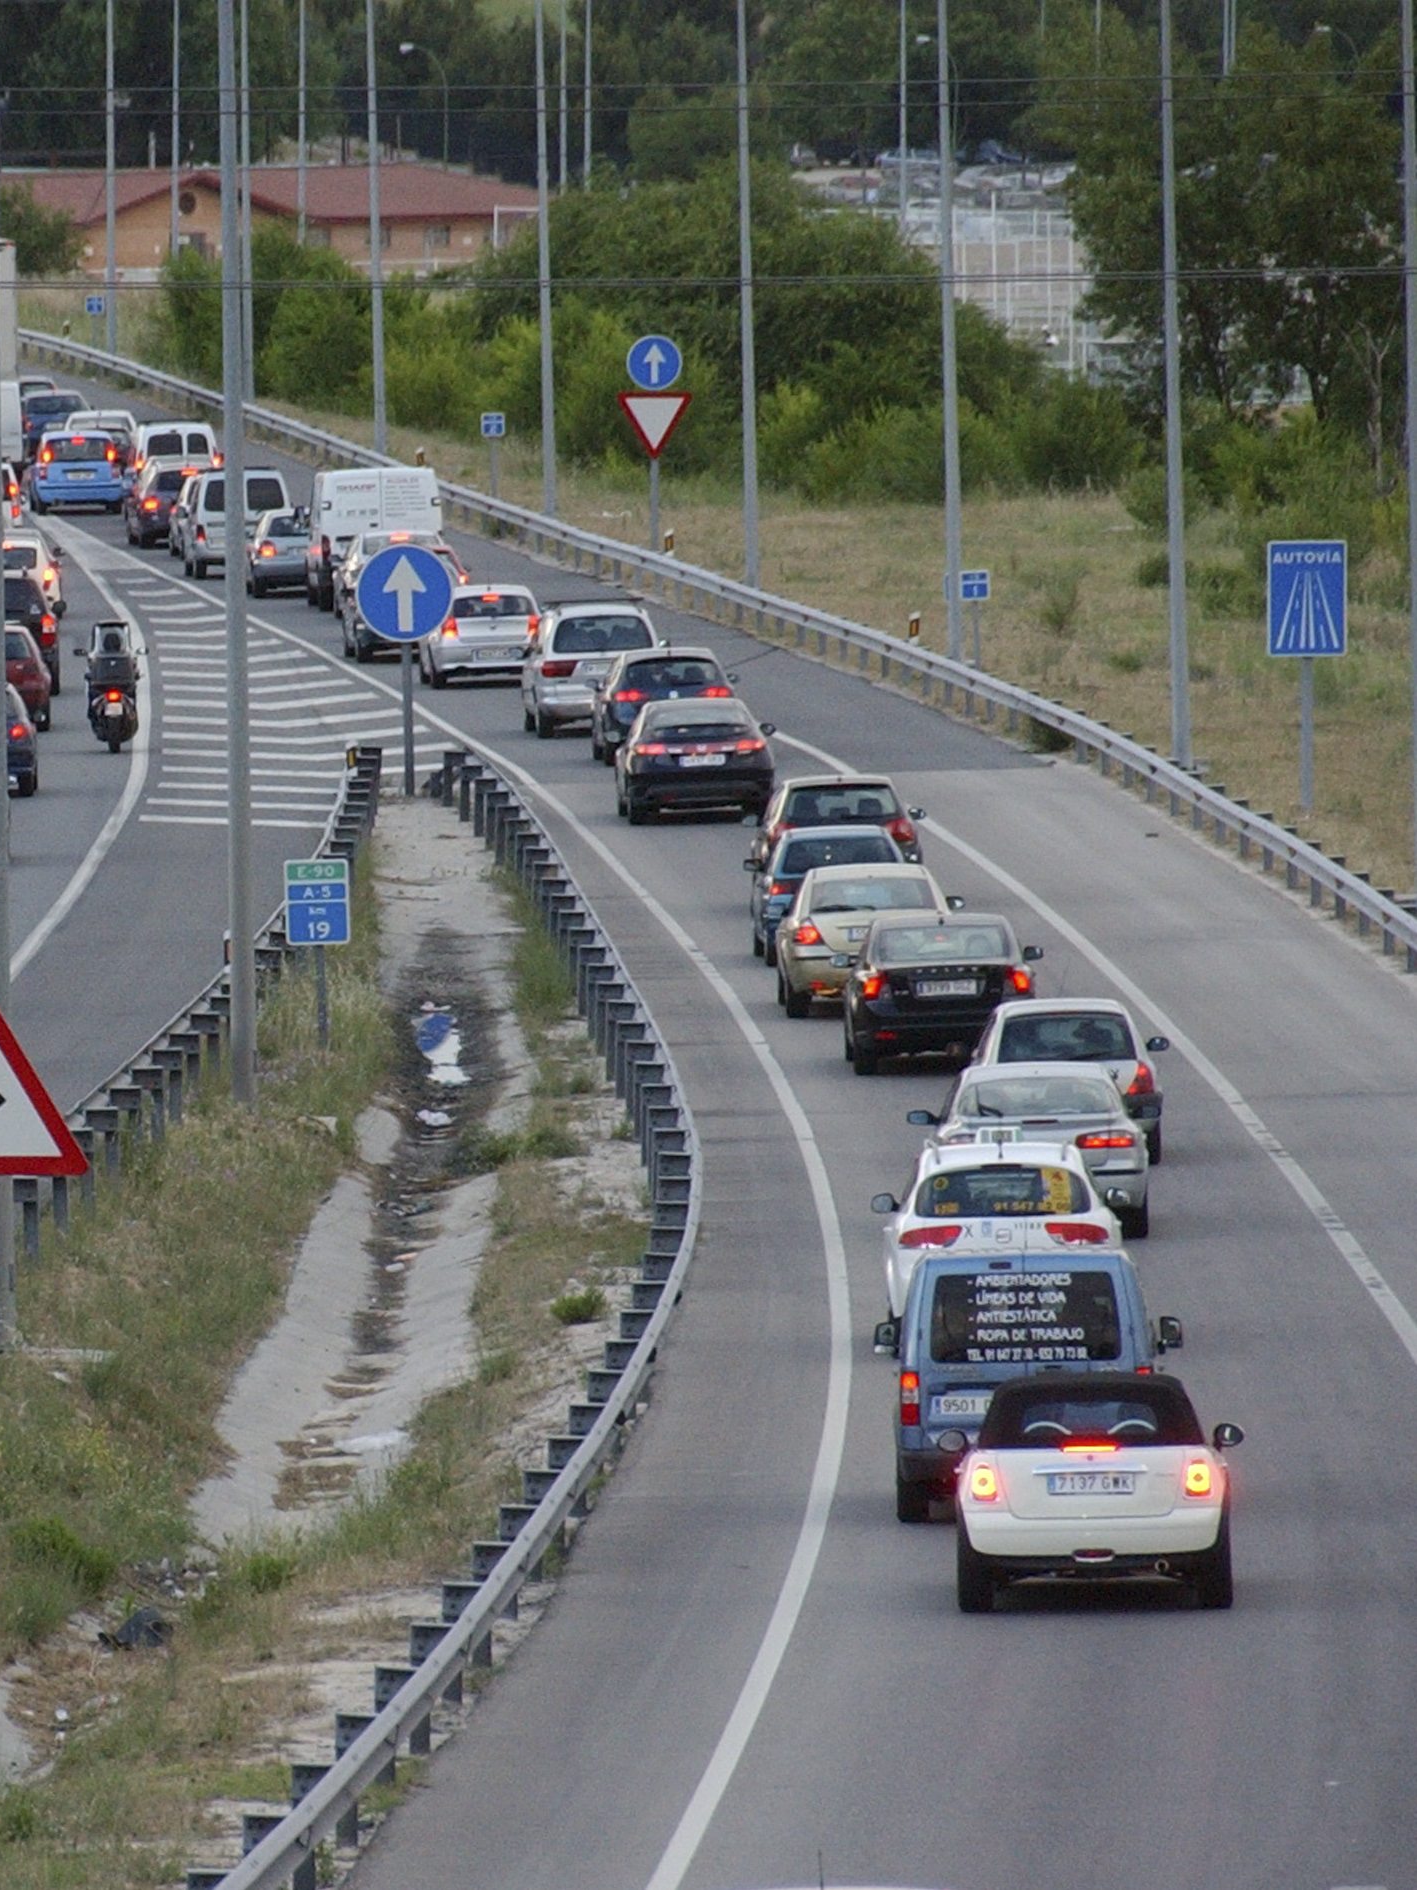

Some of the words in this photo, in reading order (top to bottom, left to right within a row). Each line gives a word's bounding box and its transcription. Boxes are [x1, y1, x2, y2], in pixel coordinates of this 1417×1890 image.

[297, 865, 335, 878] E-90
[303, 885, 331, 899] A-5
[308, 906, 327, 915] km
[308, 921, 331, 939] 19
[975, 1273, 1072, 1287] AMBIENTADORES
[1018, 1291, 1035, 1304] DE
[1037, 1291, 1067, 1303] VIDA
[977, 1328, 1009, 1342] ROPA
[1011, 1328, 1028, 1341] DE
[1030, 1327, 1085, 1341] TRABAJO
[942, 1398, 976, 1413] 9501
[1058, 1475, 1097, 1490] 7137
